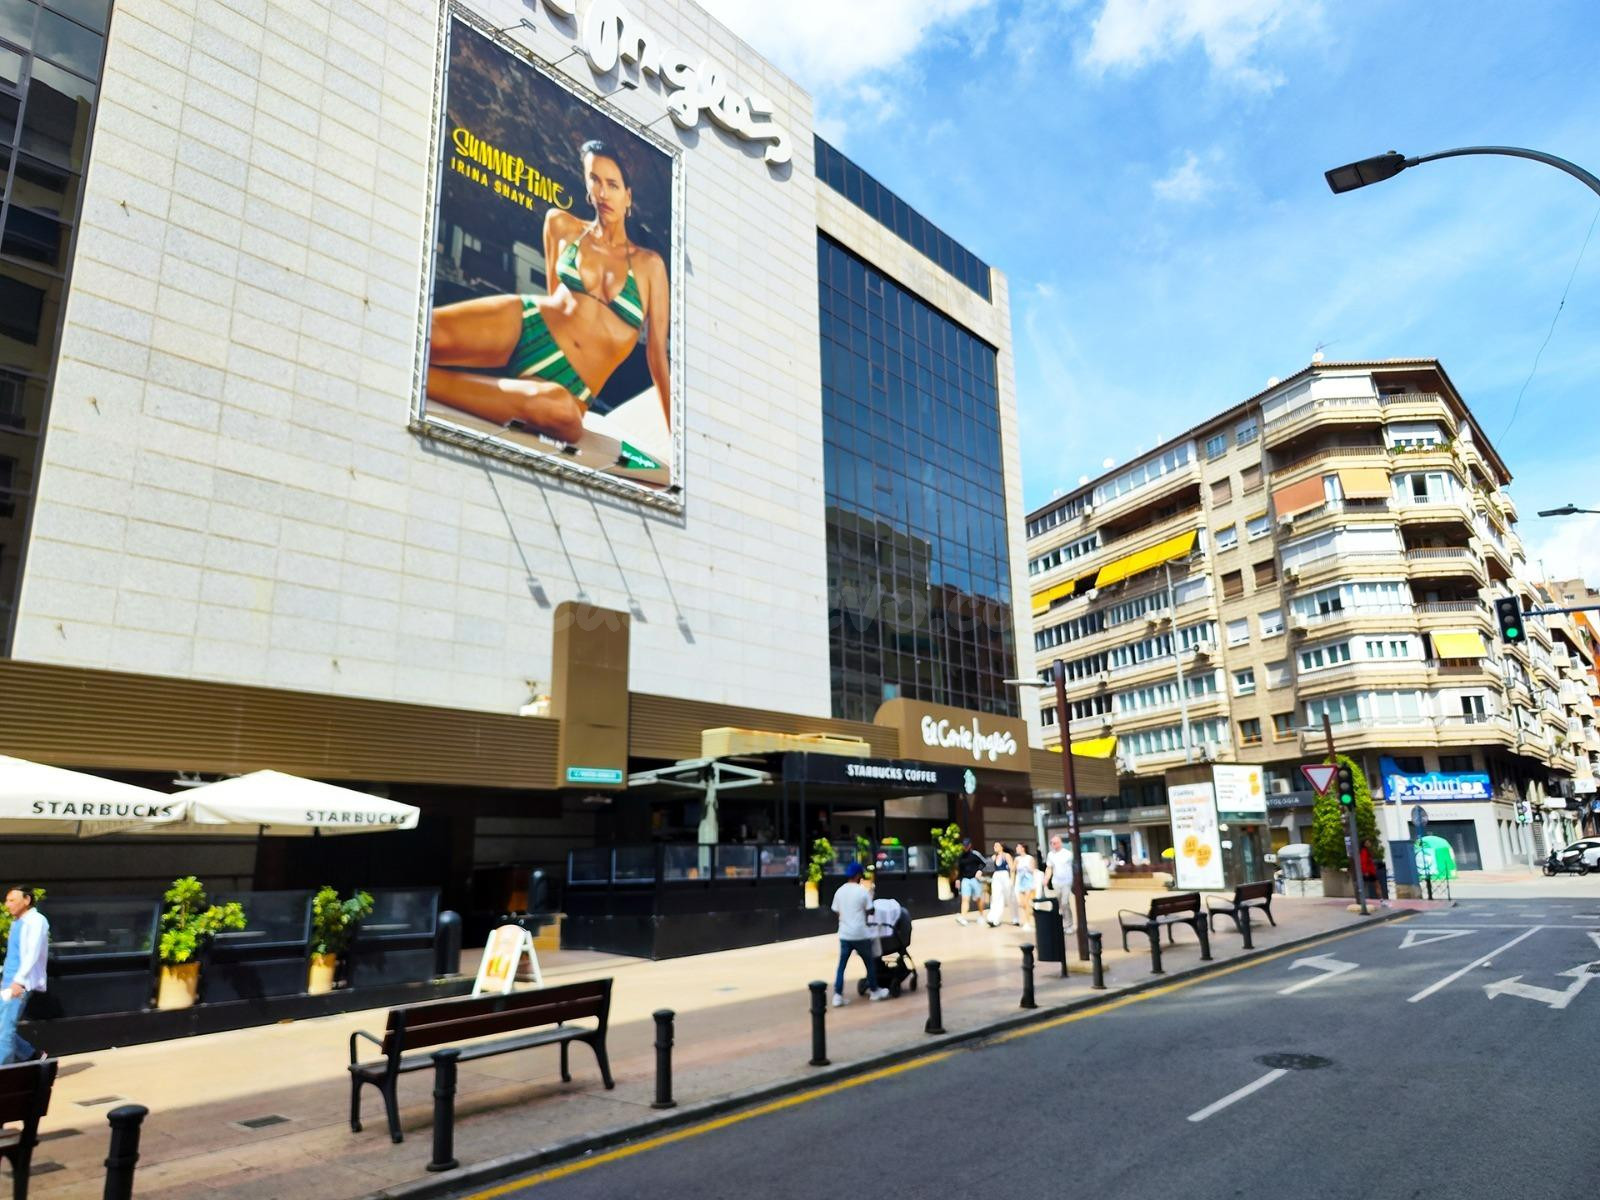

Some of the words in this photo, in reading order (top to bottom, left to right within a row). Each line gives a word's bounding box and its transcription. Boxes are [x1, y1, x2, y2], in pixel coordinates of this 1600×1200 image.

[451, 157, 488, 187] IRINA
[493, 179, 534, 211] SHAYK
[847, 764, 903, 780] STARBUCKS
[904, 769, 937, 783] COFFEE
[32, 801, 173, 817] STARBUCKS
[304, 810, 409, 825] STARBUCKS
